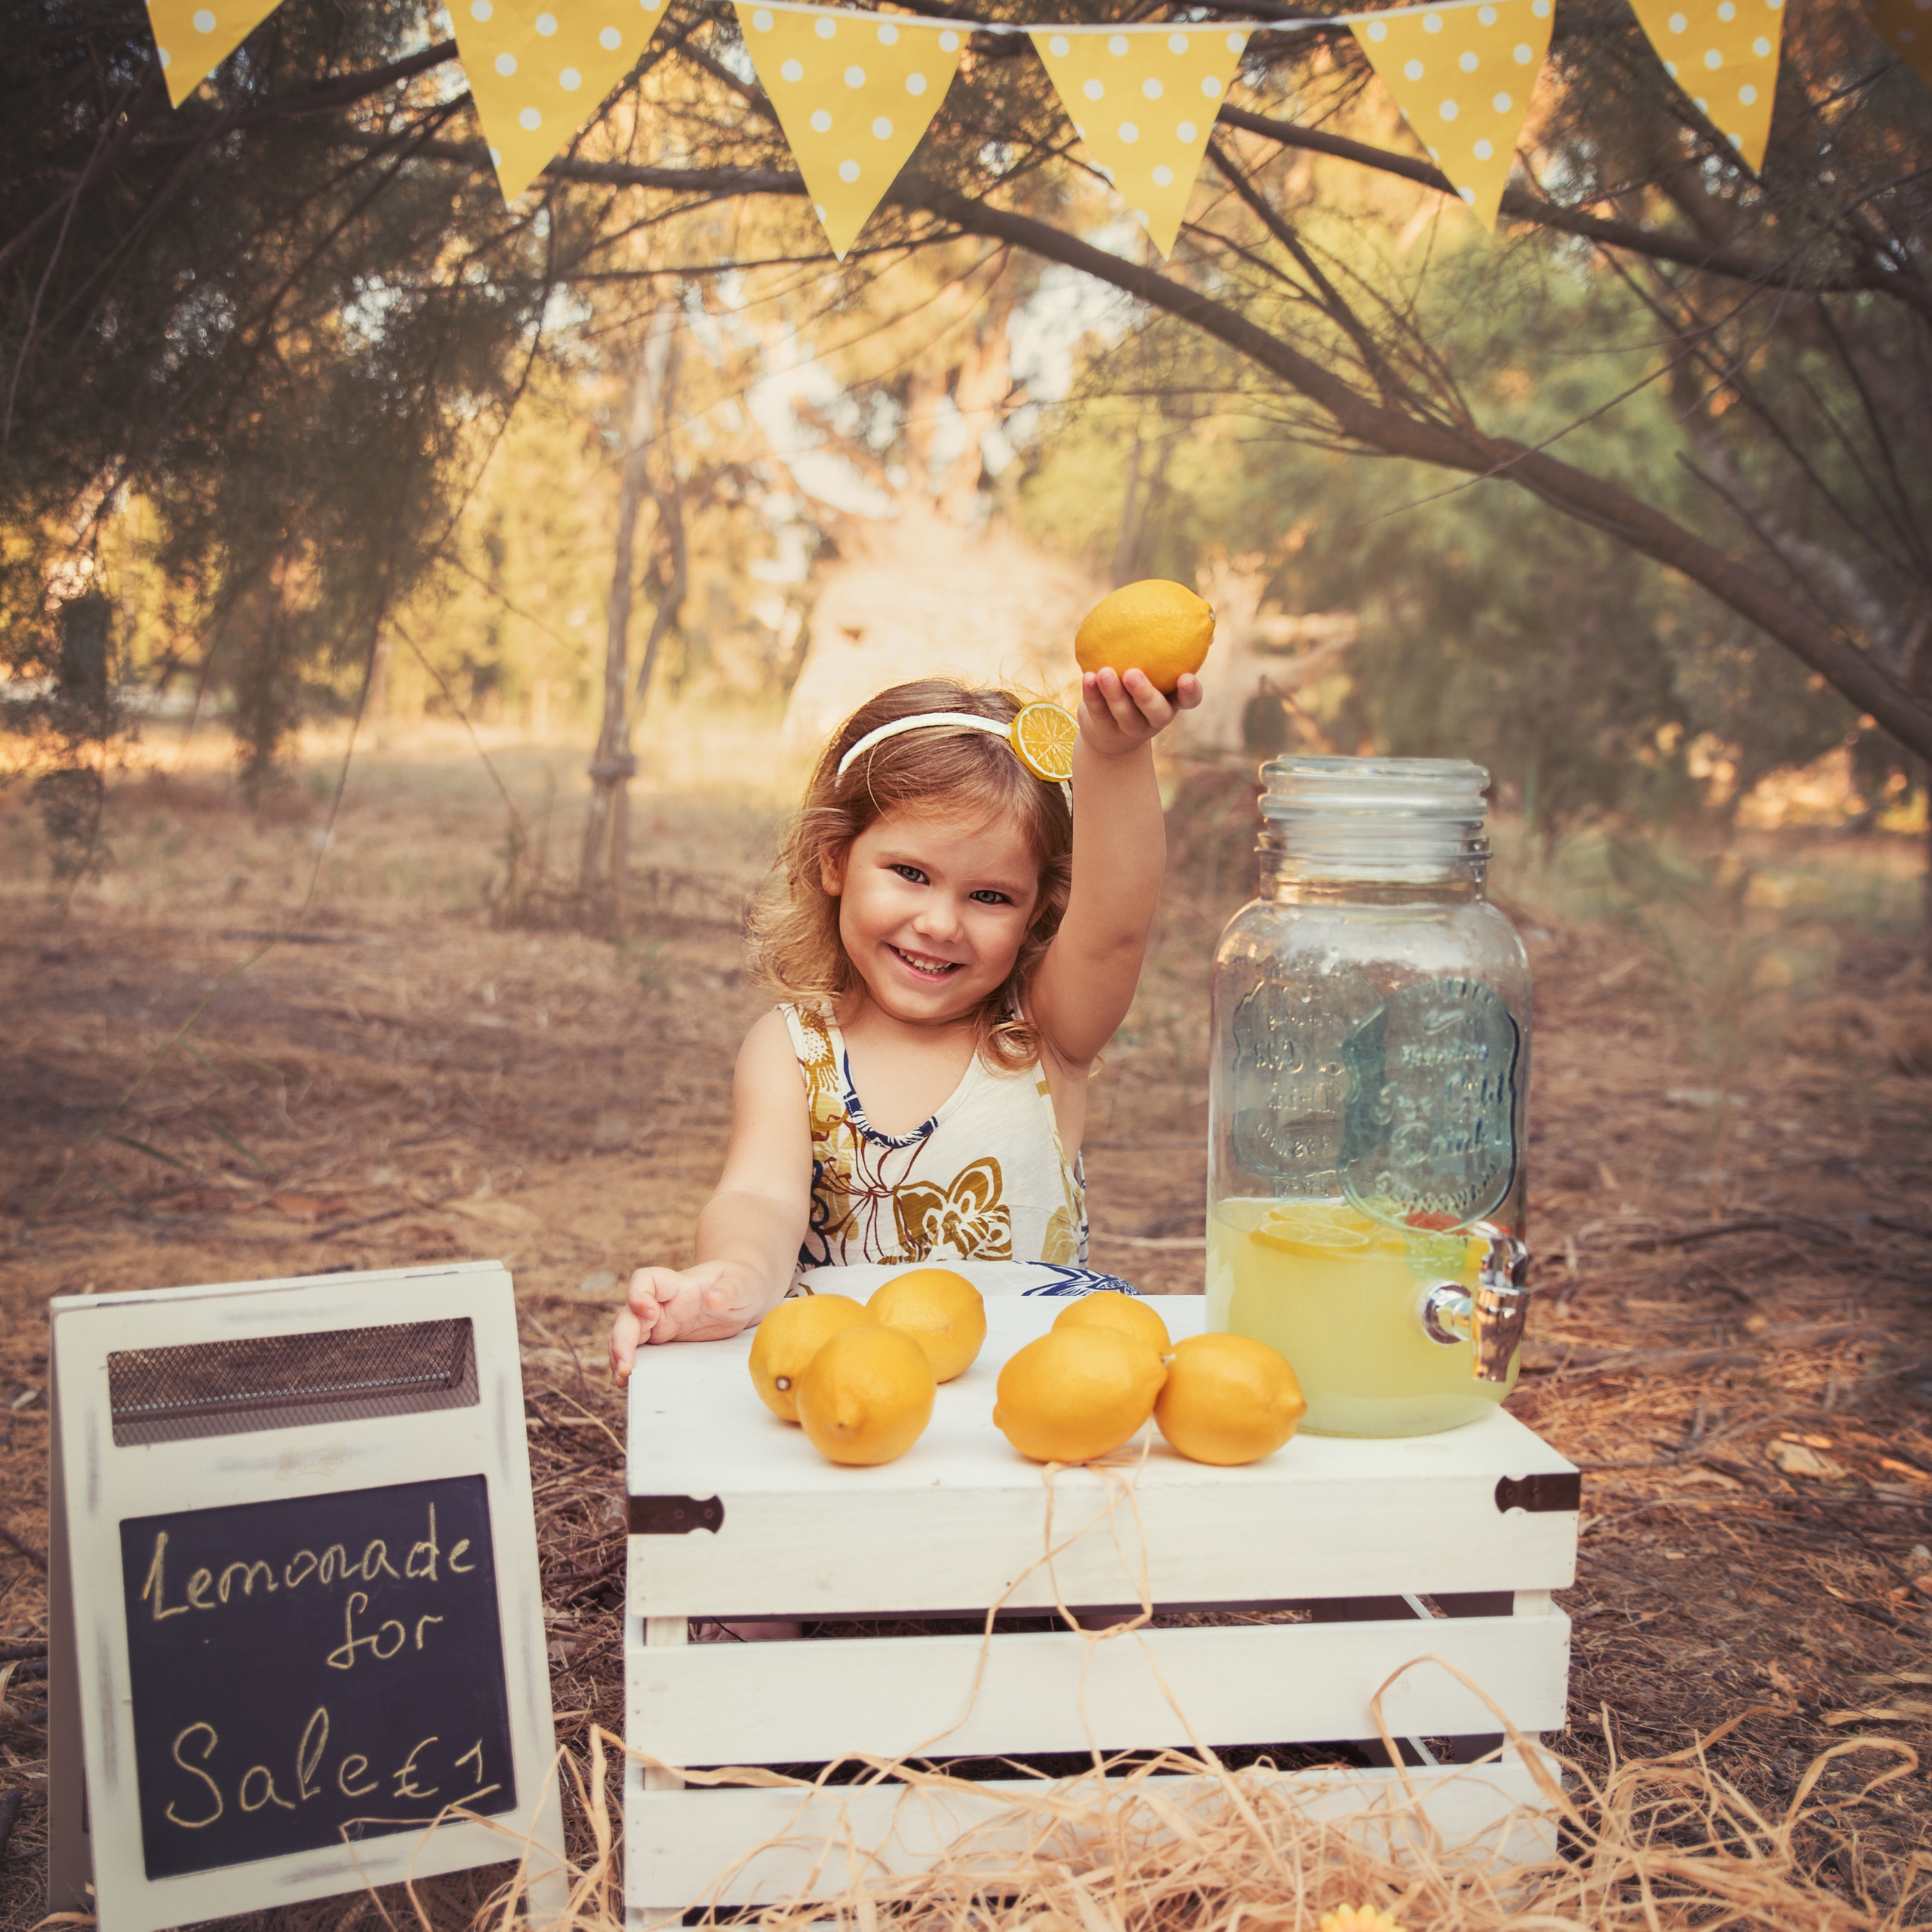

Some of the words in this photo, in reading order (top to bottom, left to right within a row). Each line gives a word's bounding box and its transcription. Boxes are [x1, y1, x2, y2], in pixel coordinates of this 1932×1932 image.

[140, 1502, 476, 1621] Lemonade
[326, 1592, 444, 1670] for
[165, 1707, 380, 1828] Sale
